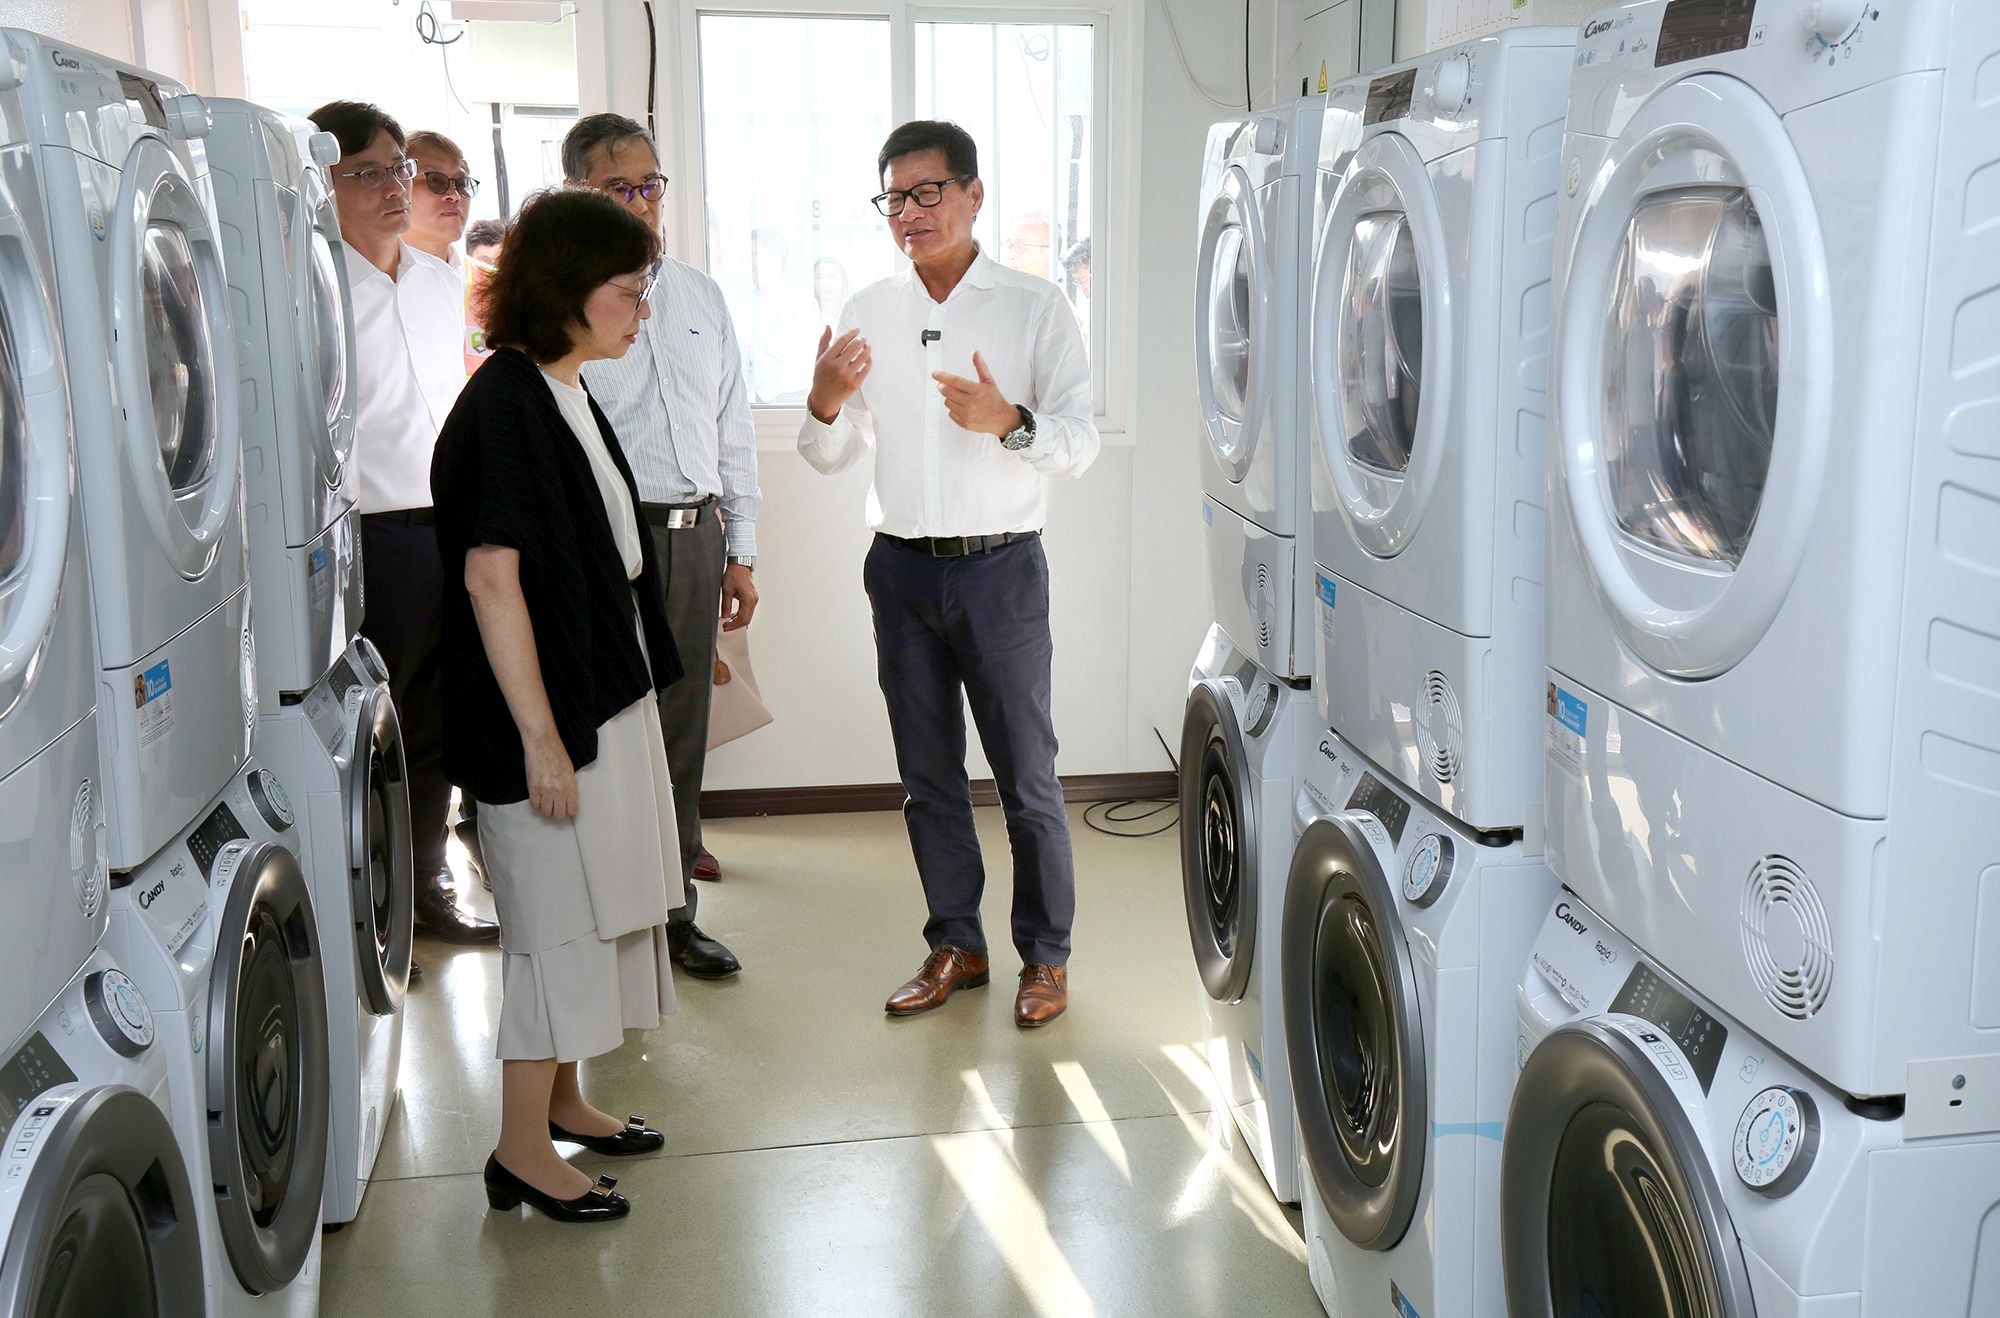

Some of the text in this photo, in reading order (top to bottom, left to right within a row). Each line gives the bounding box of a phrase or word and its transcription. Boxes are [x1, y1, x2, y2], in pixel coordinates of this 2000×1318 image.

[1584, 18, 1615, 39] CANDY
[52, 50, 80, 70] CANDY
[1319, 740, 1338, 762] CANDY
[138, 879, 165, 910] CANDY
[1555, 902, 1588, 935] CANDY
